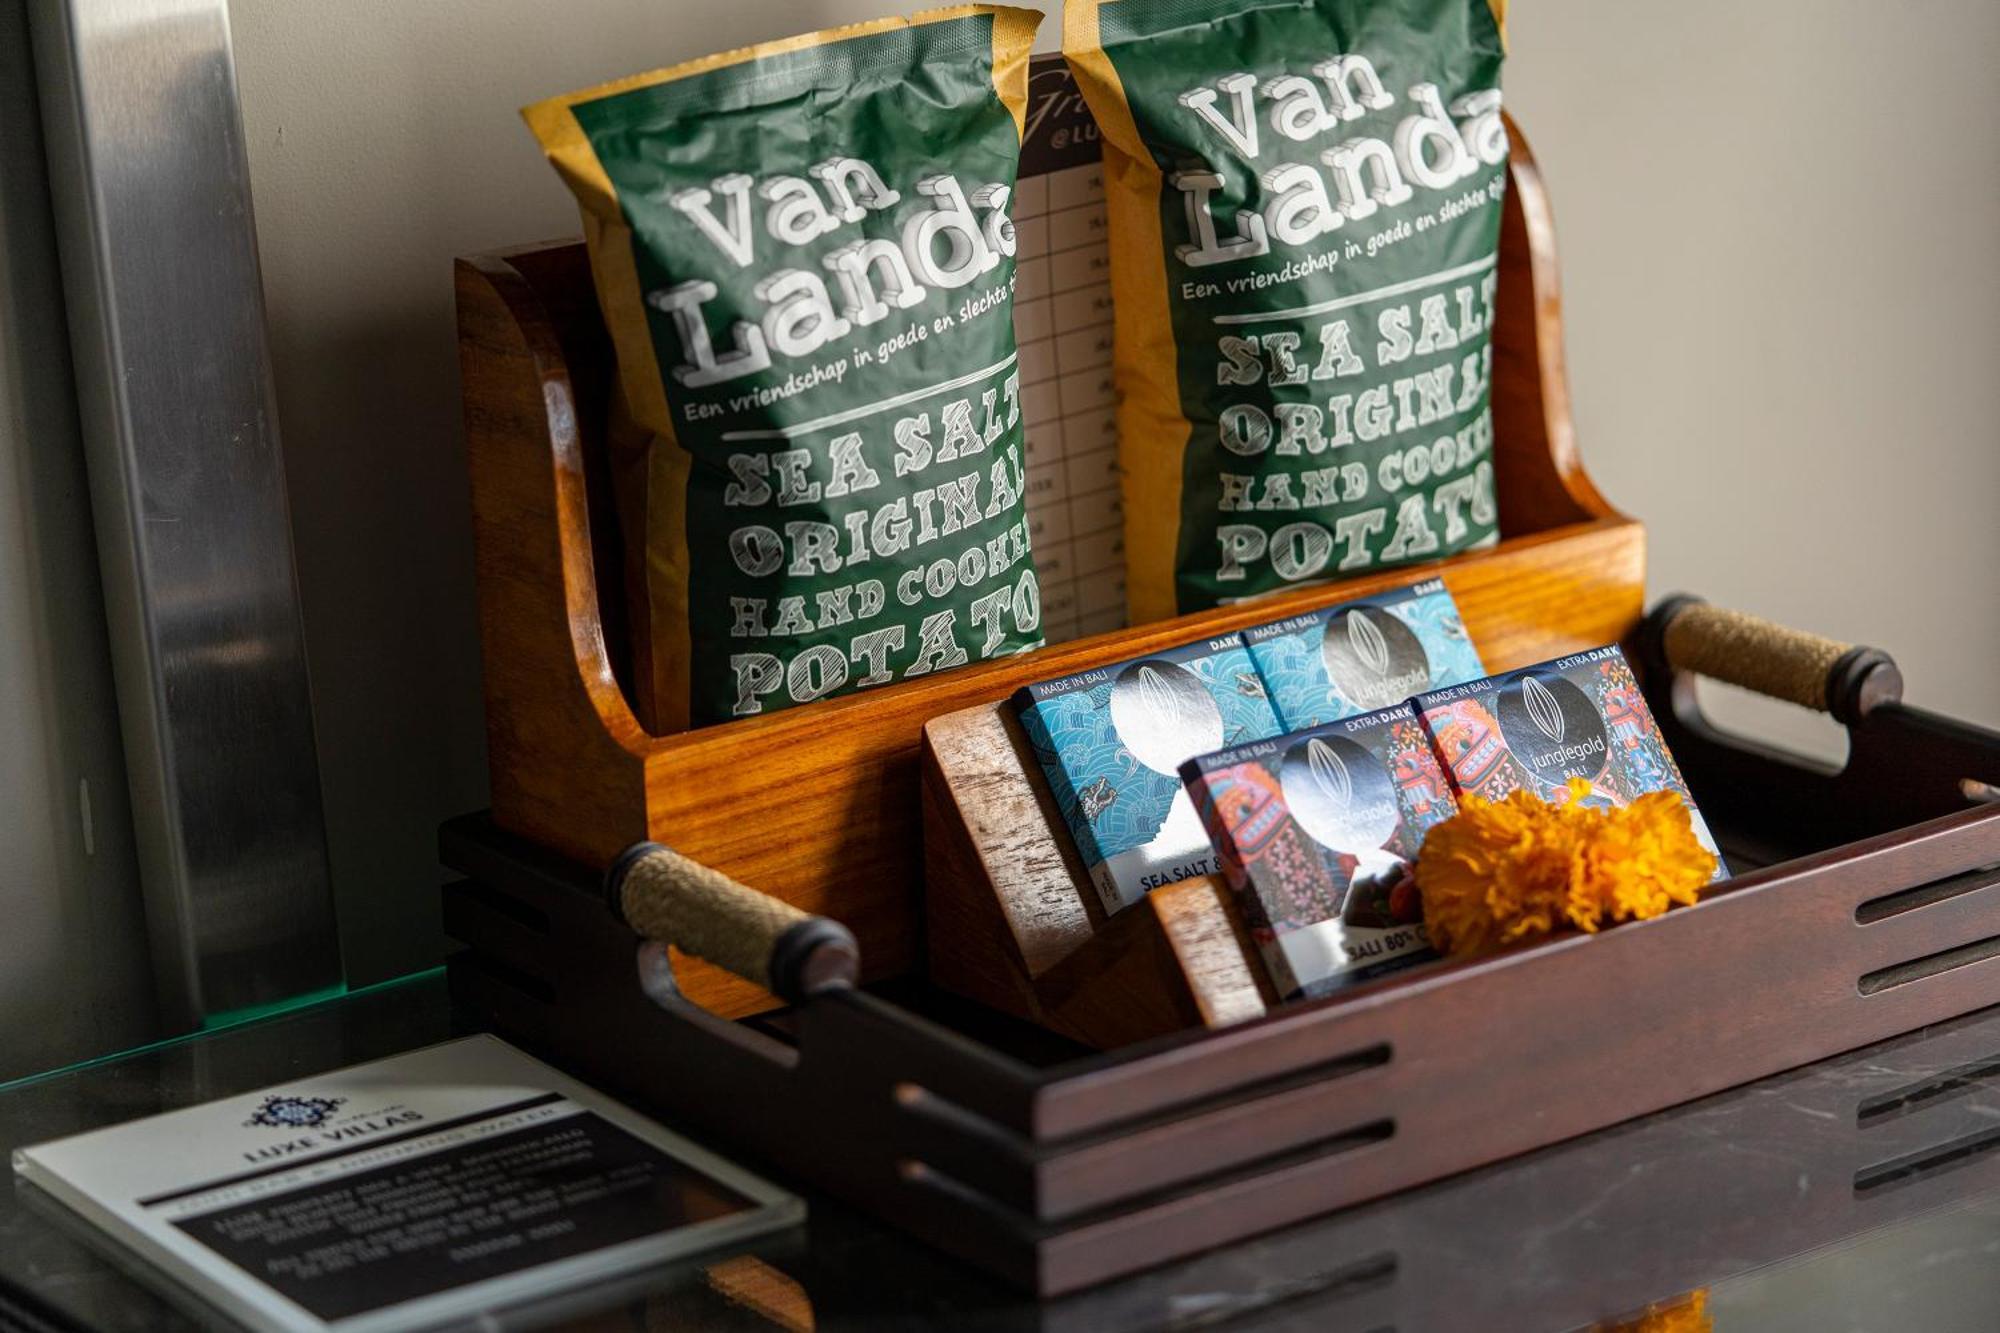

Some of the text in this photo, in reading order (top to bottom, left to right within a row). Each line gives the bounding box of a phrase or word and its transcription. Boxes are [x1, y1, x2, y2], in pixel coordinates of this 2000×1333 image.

[1177, 53, 1395, 160] Van
[1167, 82, 1509, 267] Landa
[671, 156, 900, 267] Van
[1181, 282, 1220, 300] Een
[1227, 248, 1338, 292] vriendschap
[1345, 240, 1363, 260] in
[1366, 218, 1412, 257] goede
[1415, 214, 1437, 232] en
[1439, 188, 1486, 225] slechte
[684, 402, 724, 421] Een
[728, 357, 848, 413] vriendschap
[853, 348, 873, 368] in
[878, 323, 929, 365] goede
[933, 315, 955, 334] en
[960, 285, 1008, 323] slechte
[1217, 319, 1365, 387] SEA
[724, 432, 880, 507] SEA
[1218, 462, 1369, 512] HAND
[728, 443, 1025, 577] ORIGINAL
[730, 579, 885, 638] HAND
[1412, 579, 1445, 597] DARK
[730, 569, 1040, 716] POTATO
[1208, 634, 1242, 651] DARK
[1254, 613, 1319, 639] MADE IN BALI
[1557, 644, 1621, 671] EXTRA DARK
[1040, 670, 1109, 697] MADE IN BALI
[1353, 667, 1429, 704] junglegold
[1426, 690, 1457, 705] MADE
[1457, 685, 1470, 696] IN
[1471, 679, 1493, 694] BALI
[1345, 706, 1413, 732] EXTRA DARK
[1207, 741, 1277, 767] MADE IN BALI
[1531, 735, 1606, 772] junglegold
[1562, 764, 1588, 780] BALI
[1140, 871, 1173, 892] SEA
[1172, 859, 1210, 883] SALT
[1212, 855, 1222, 871] &
[241, 1138, 318, 1163] LUXE
[322, 1110, 424, 1142] VILLAS
